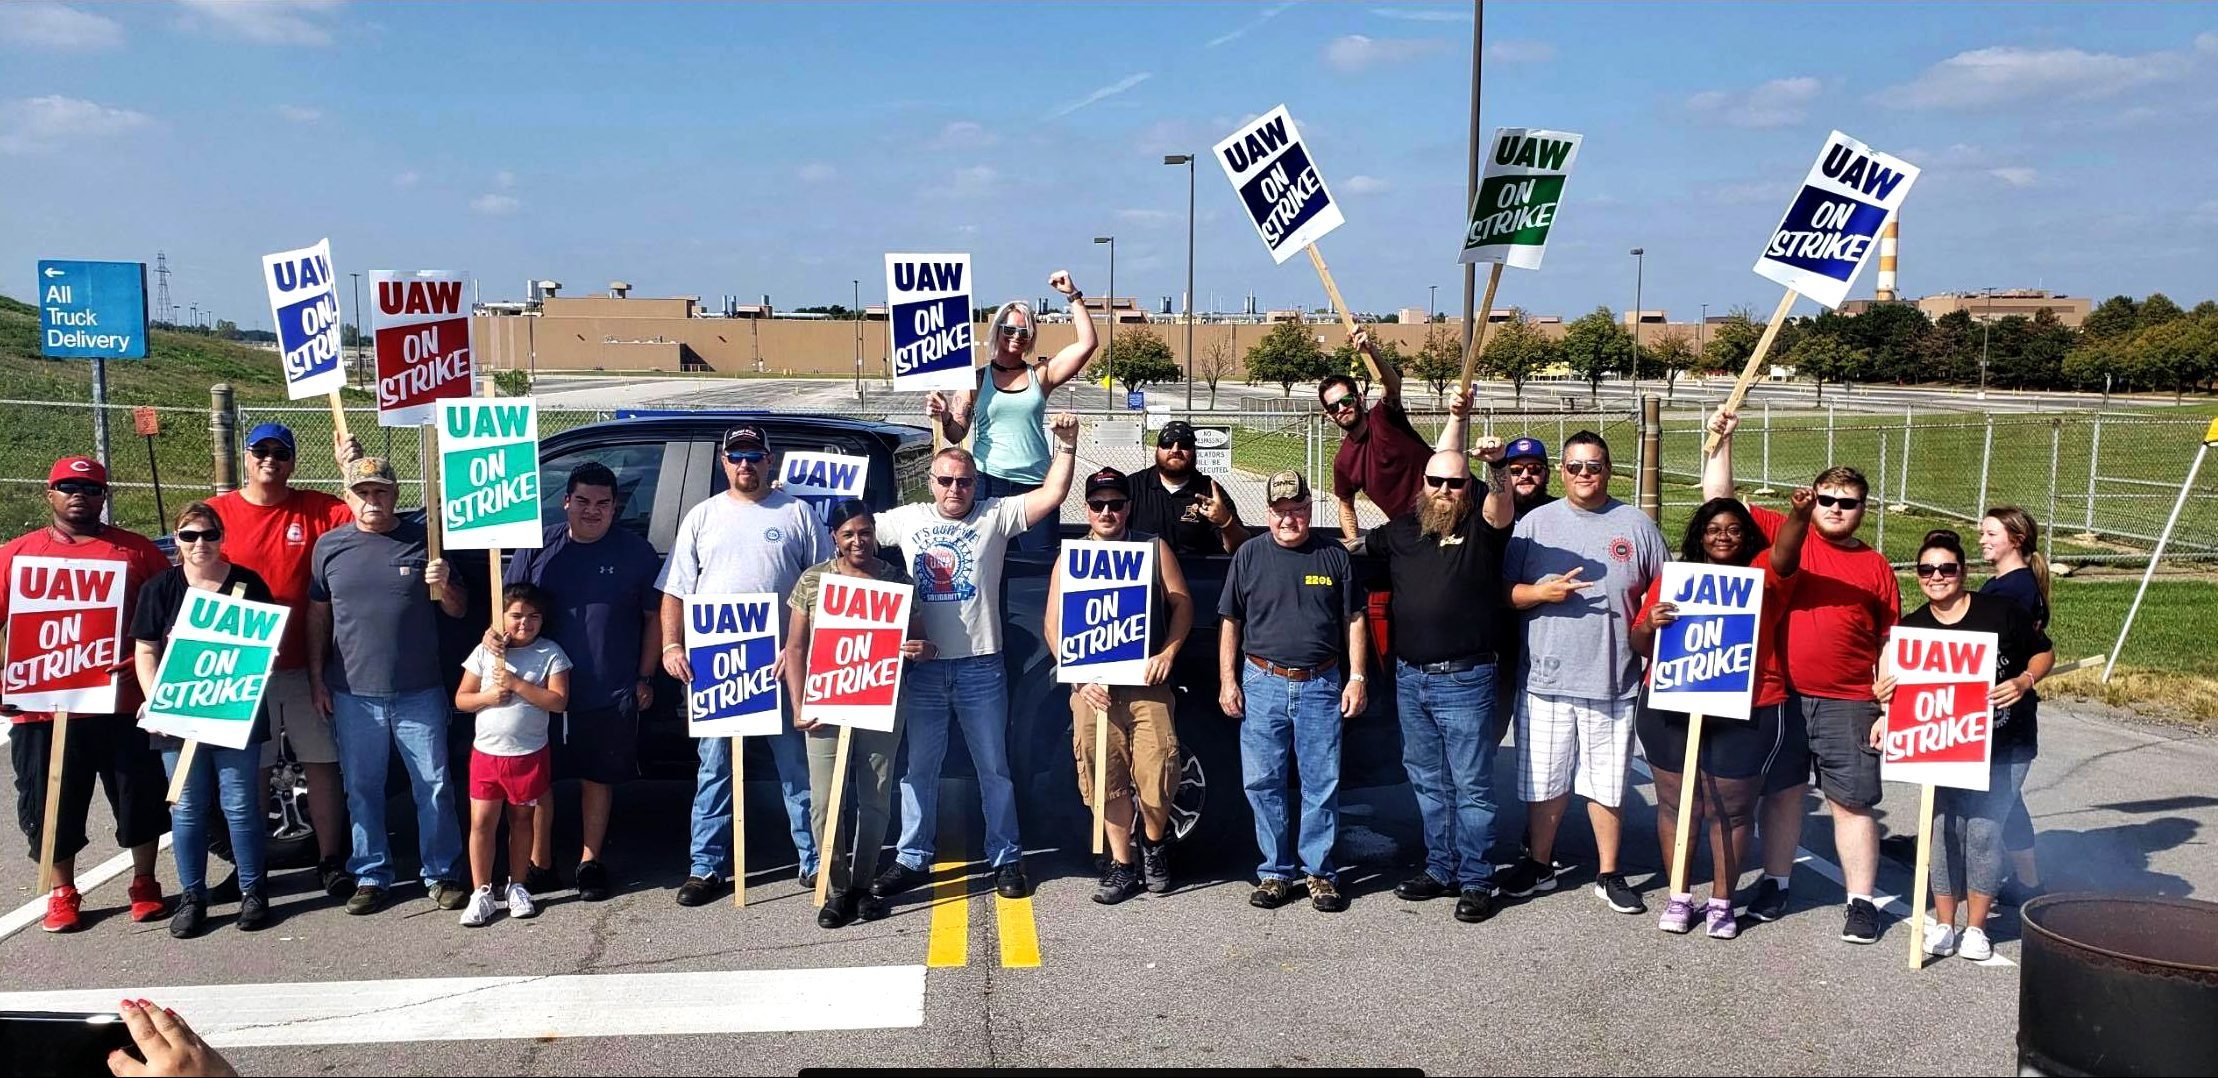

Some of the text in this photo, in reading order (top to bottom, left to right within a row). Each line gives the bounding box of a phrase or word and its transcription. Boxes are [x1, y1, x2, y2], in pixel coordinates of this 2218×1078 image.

[1223, 115, 1289, 173] UAW
[1495, 135, 1574, 171] UAW
[1260, 161, 1290, 204] ON
[1822, 142, 1905, 202] UAW
[1261, 165, 1321, 248] STRIKE
[1497, 178, 1537, 209] ON
[1466, 202, 1557, 246] STRIKE
[1811, 200, 1857, 230] ON
[1767, 229, 1872, 262] STRIKE
[46, 285, 72, 303] All
[893, 262, 964, 292] UAW
[46, 307, 98, 326] Truck
[302, 295, 333, 336] ON
[378, 281, 462, 315] UAW
[914, 301, 945, 336] ON
[47, 329, 130, 353] Delivery
[286, 323, 339, 380] STRI
[403, 325, 439, 364] ON
[895, 322, 971, 374] STRIKE
[380, 348, 471, 407] STRIKE
[446, 405, 529, 438] UAW
[70, 460, 90, 472] C
[469, 448, 506, 487] ON
[787, 459, 860, 491] UAW
[447, 471, 538, 529] STRIKE
[1069, 548, 1145, 581] UAW
[19, 566, 115, 602] UAW
[189, 597, 280, 641] UAW
[692, 602, 770, 634] UAW
[823, 584, 904, 623] UAW
[1085, 590, 1119, 626] ON
[39, 613, 82, 650] ON
[835, 631, 873, 666] ON
[1061, 613, 1146, 665] STRIKE
[1684, 617, 1724, 652] ON
[6, 637, 115, 691] STRIKE
[193, 647, 241, 678] ON
[713, 643, 747, 680] ON
[1655, 643, 1752, 690] STRIKE
[1897, 638, 1987, 675] UAW
[152, 674, 266, 710] STRIKE
[692, 663, 776, 719] STRIKE
[805, 657, 899, 703] STRIKE
[1914, 685, 1956, 722] ON
[1886, 711, 1988, 761] STRIKE
